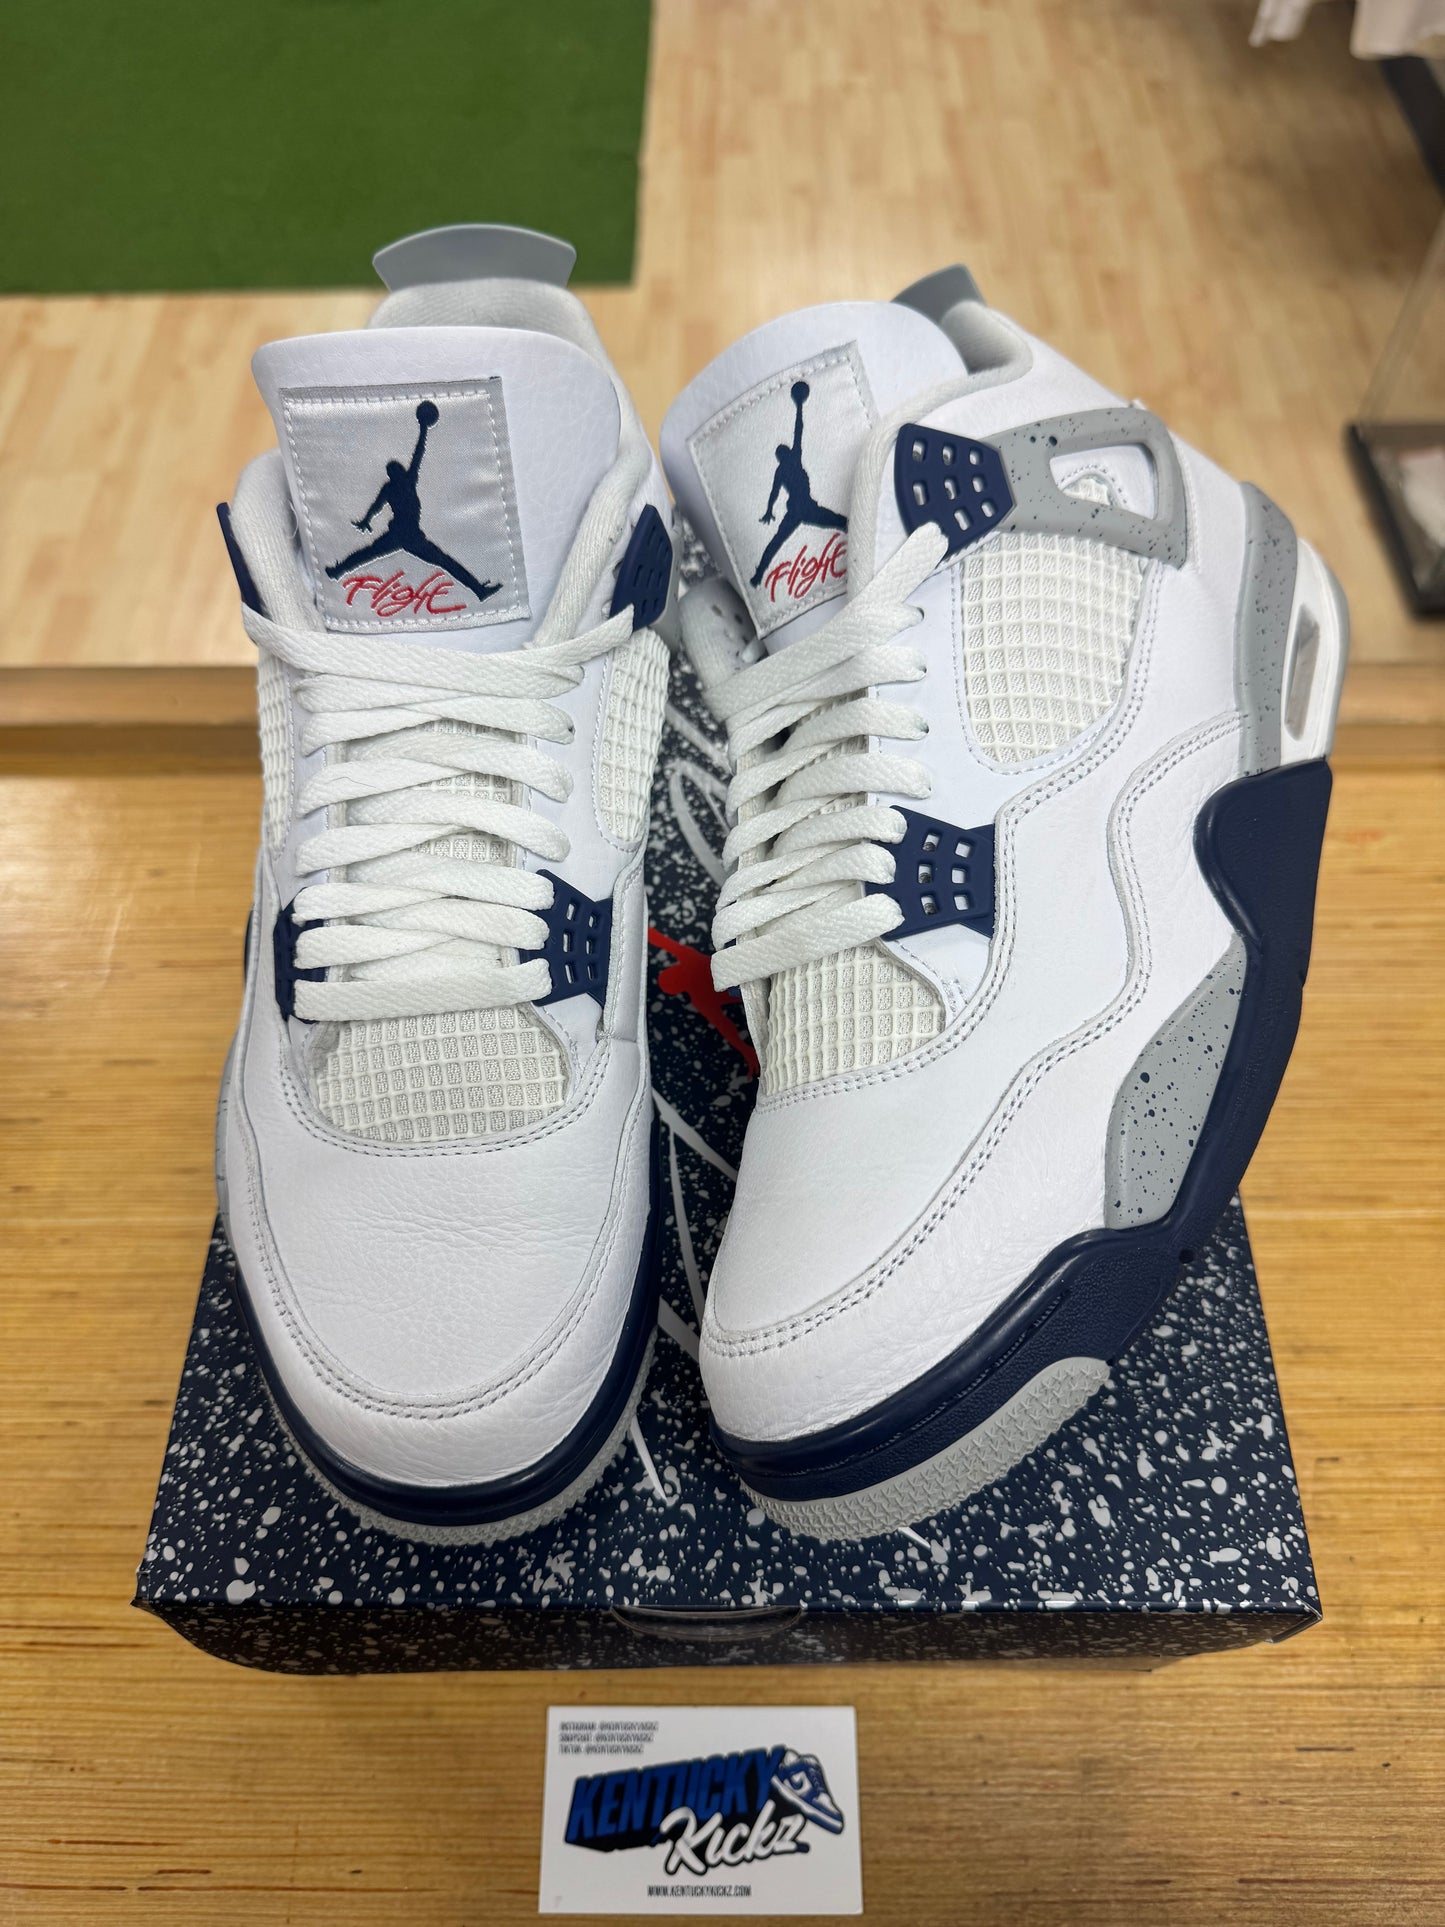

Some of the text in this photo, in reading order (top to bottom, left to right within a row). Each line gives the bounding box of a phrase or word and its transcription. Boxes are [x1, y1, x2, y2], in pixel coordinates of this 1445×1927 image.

[343, 569, 468, 617] Flight
[764, 532, 848, 603] Flight
[566, 1746, 783, 1850] KENTUCKY
[659, 1799, 809, 1876] Kickz
